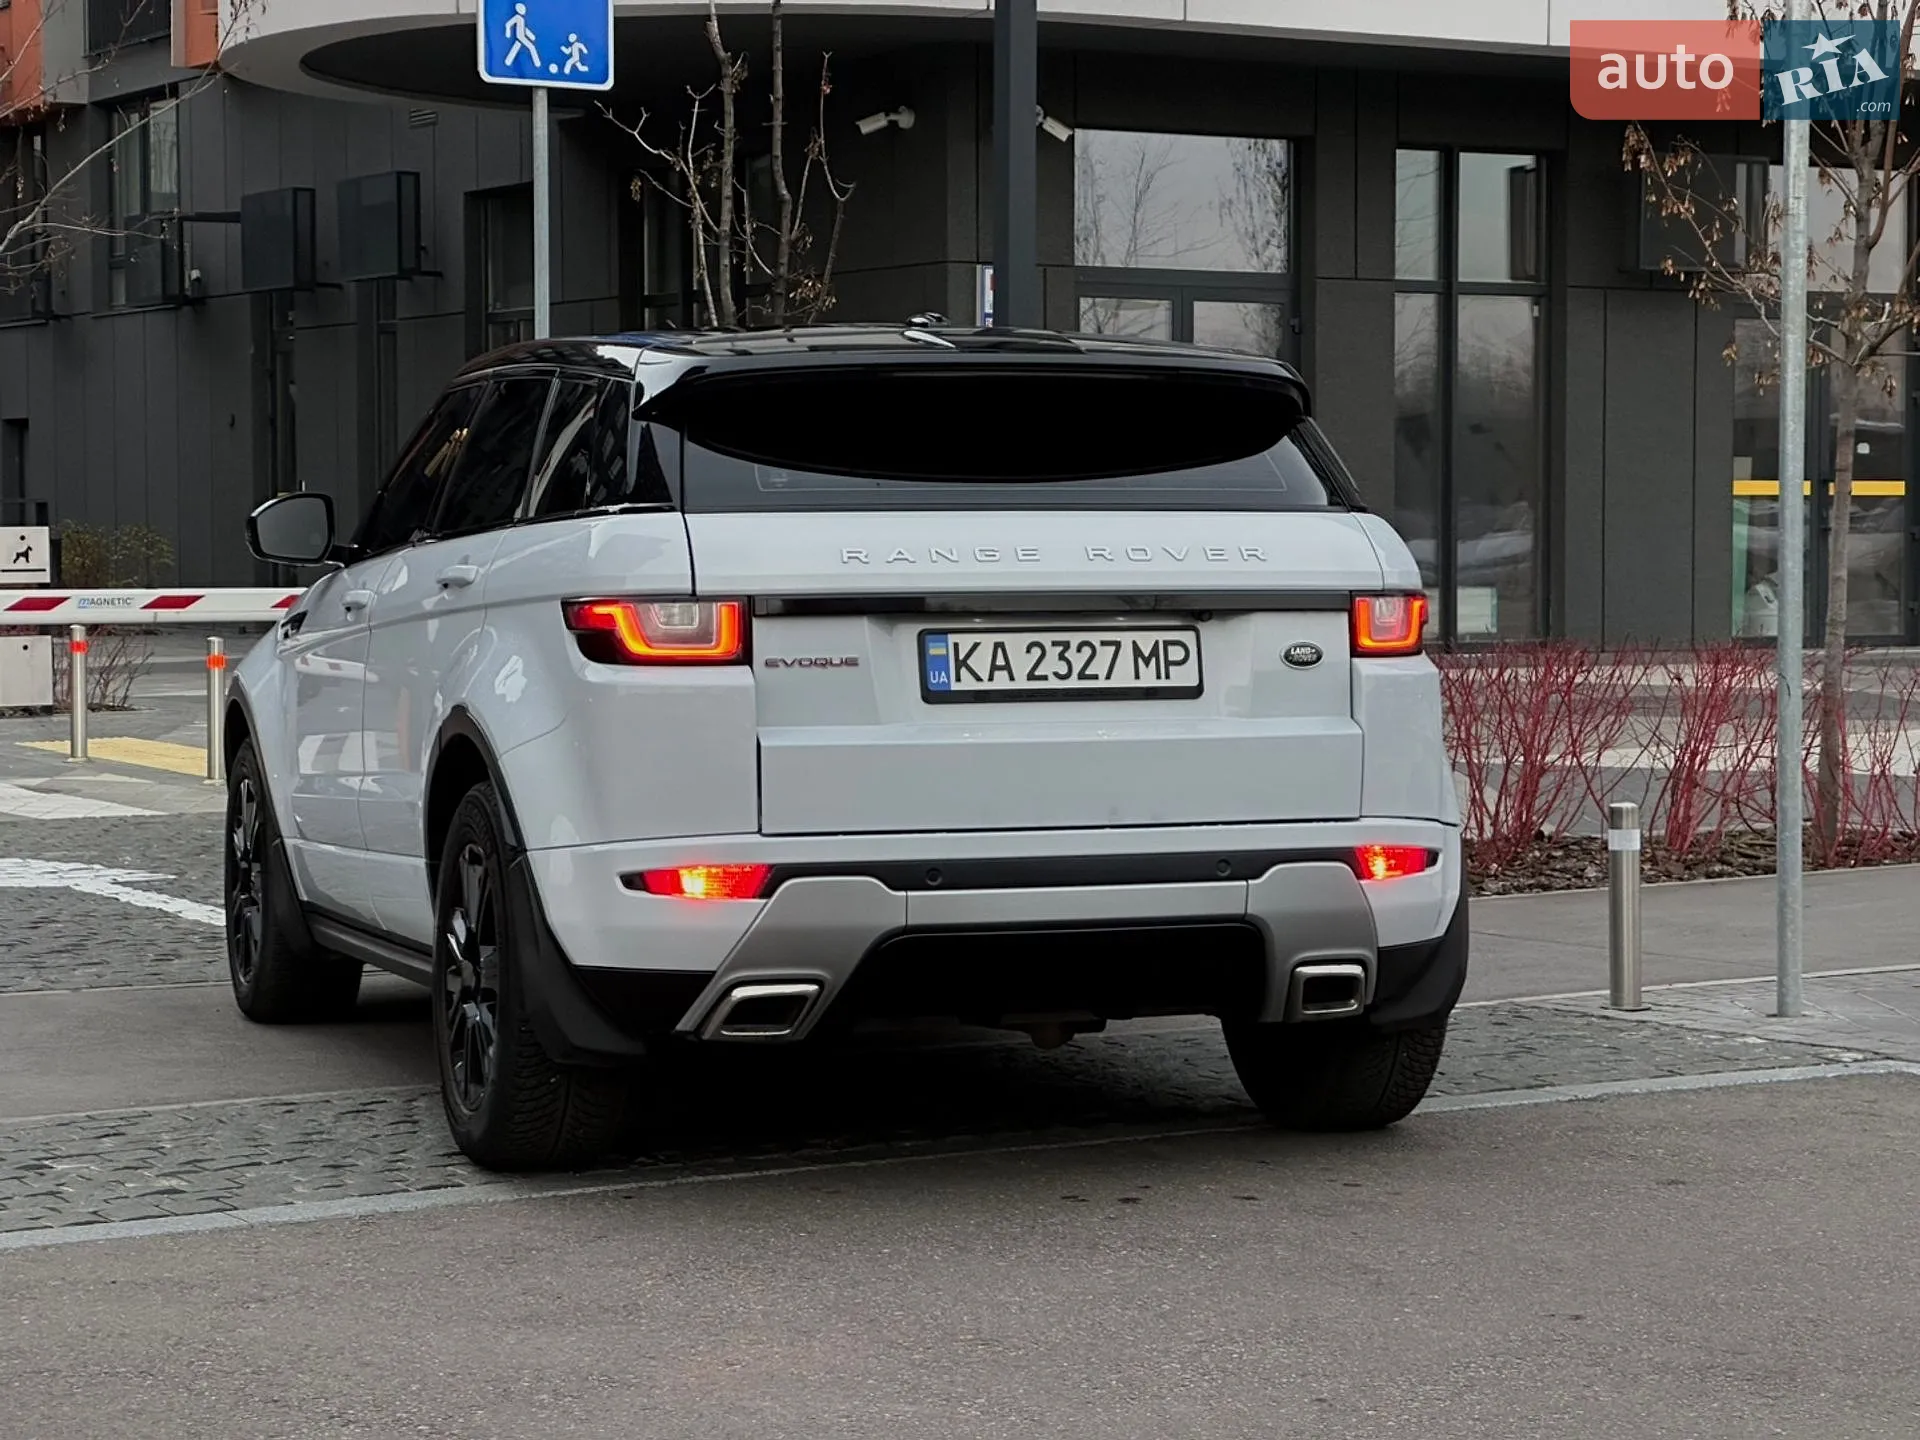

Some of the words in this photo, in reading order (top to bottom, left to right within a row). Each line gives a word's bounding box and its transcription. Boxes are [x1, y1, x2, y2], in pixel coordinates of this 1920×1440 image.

[840, 546, 1041, 564] RANGE
[1085, 545, 1268, 562] ROVER
[764, 656, 860, 669] EVOQUE
[952, 640, 1016, 683] KA
[1025, 640, 1122, 682] 2327
[1132, 639, 1191, 681] MP
[930, 670, 949, 684] UA
